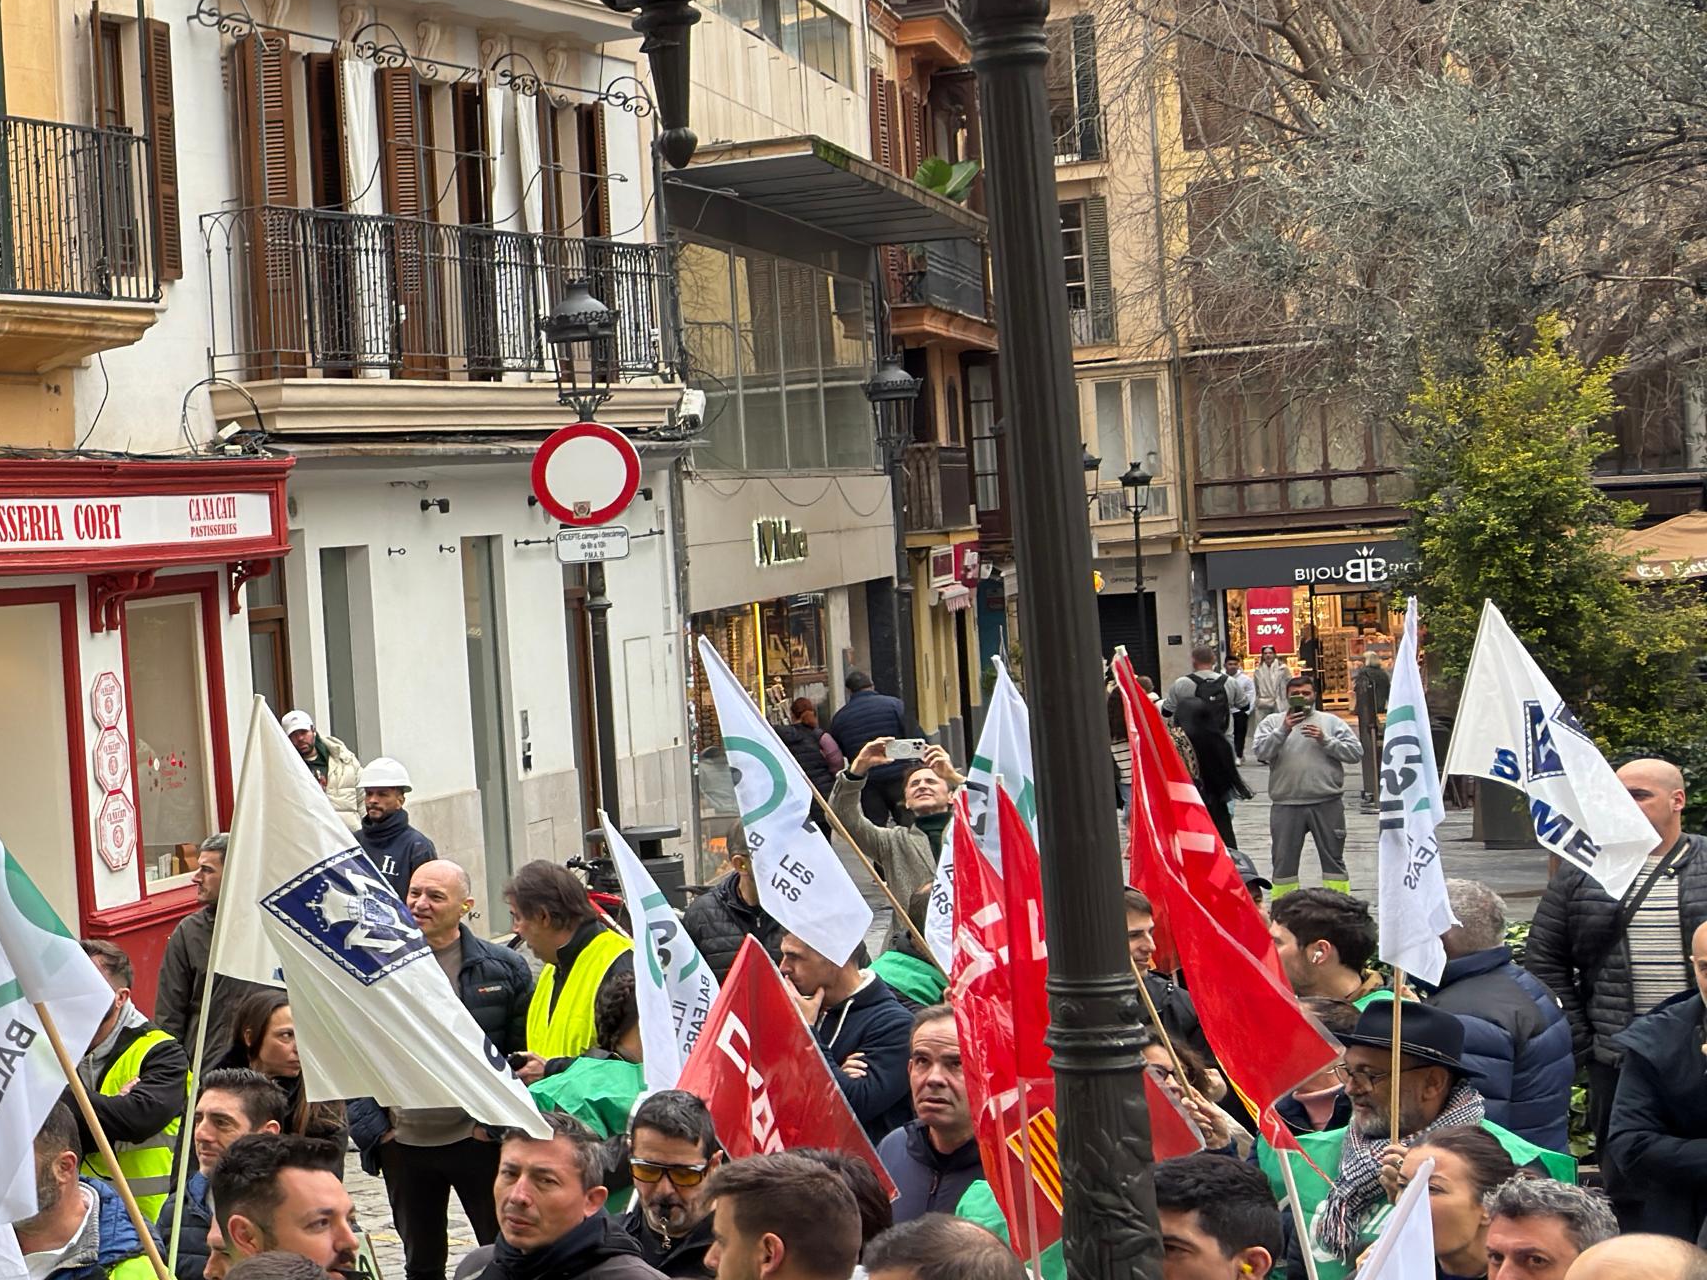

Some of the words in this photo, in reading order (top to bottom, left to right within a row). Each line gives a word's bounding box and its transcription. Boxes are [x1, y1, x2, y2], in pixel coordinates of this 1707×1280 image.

[189, 499, 201, 521] CA
[202, 498, 215, 520] NA
[216, 496, 237, 519] CATI
[73, 504, 122, 540] CORT
[190, 522, 237, 538] PASTISSERIES
[1295, 568, 1344, 583] BIJOU
[1249, 607, 1290, 616] REDUCIDO
[1256, 624, 1284, 636] 50%
